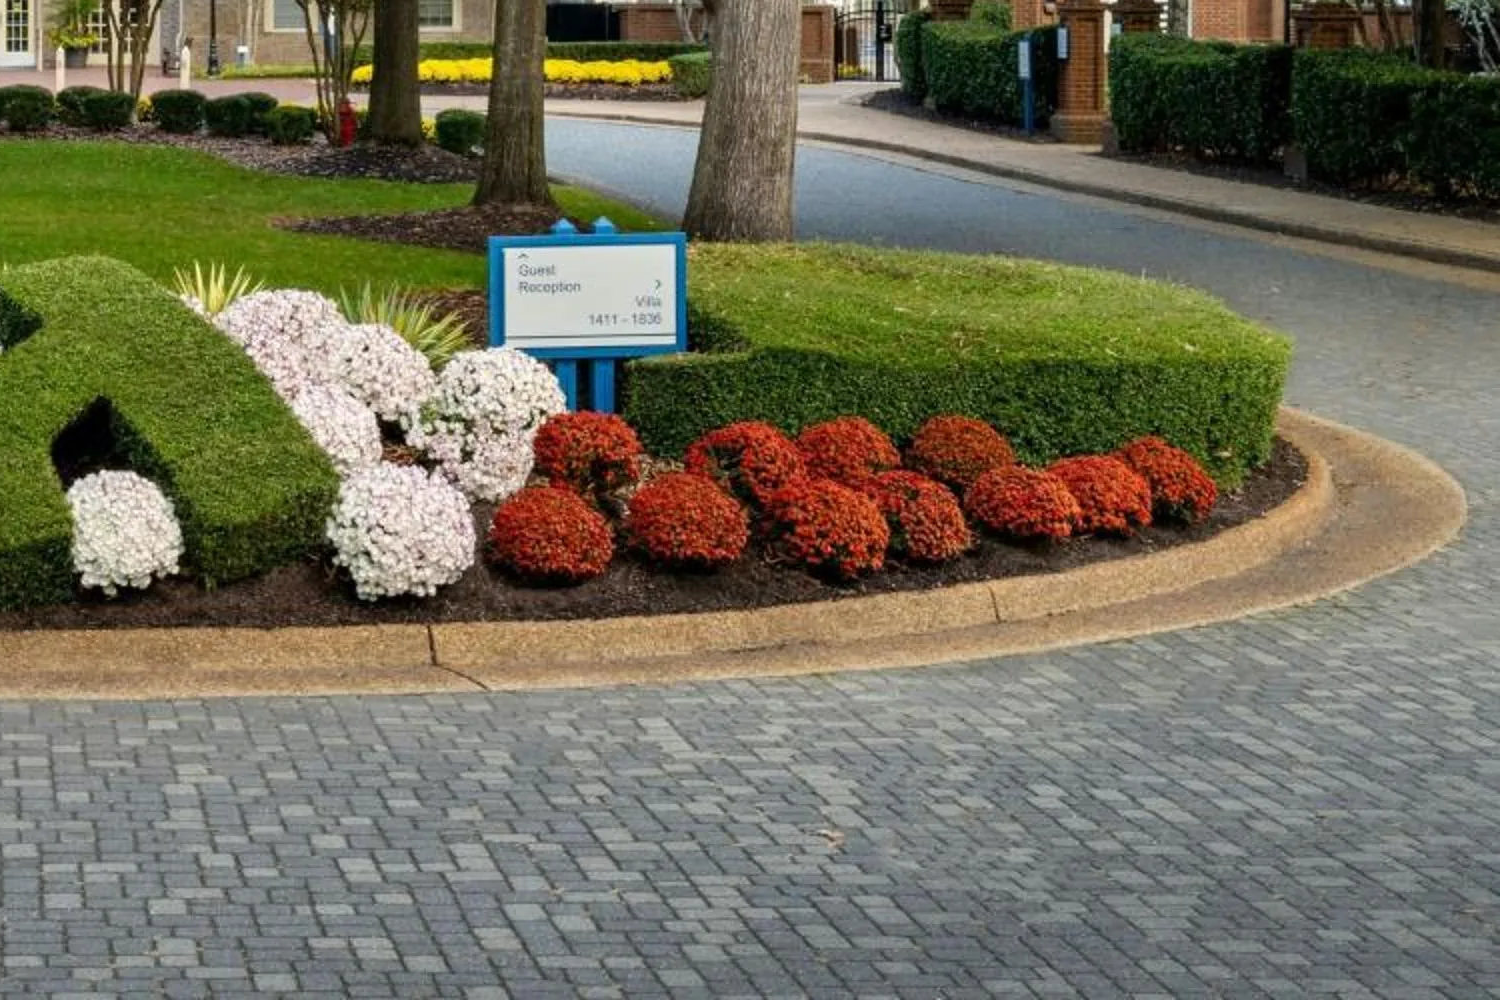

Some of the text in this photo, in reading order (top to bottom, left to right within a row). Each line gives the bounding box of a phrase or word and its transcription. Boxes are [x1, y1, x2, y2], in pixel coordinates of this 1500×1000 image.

[518, 264, 557, 278] Guest
[518, 281, 582, 296] Reception
[635, 295, 662, 307] Villa
[588, 313, 618, 326] 1411
